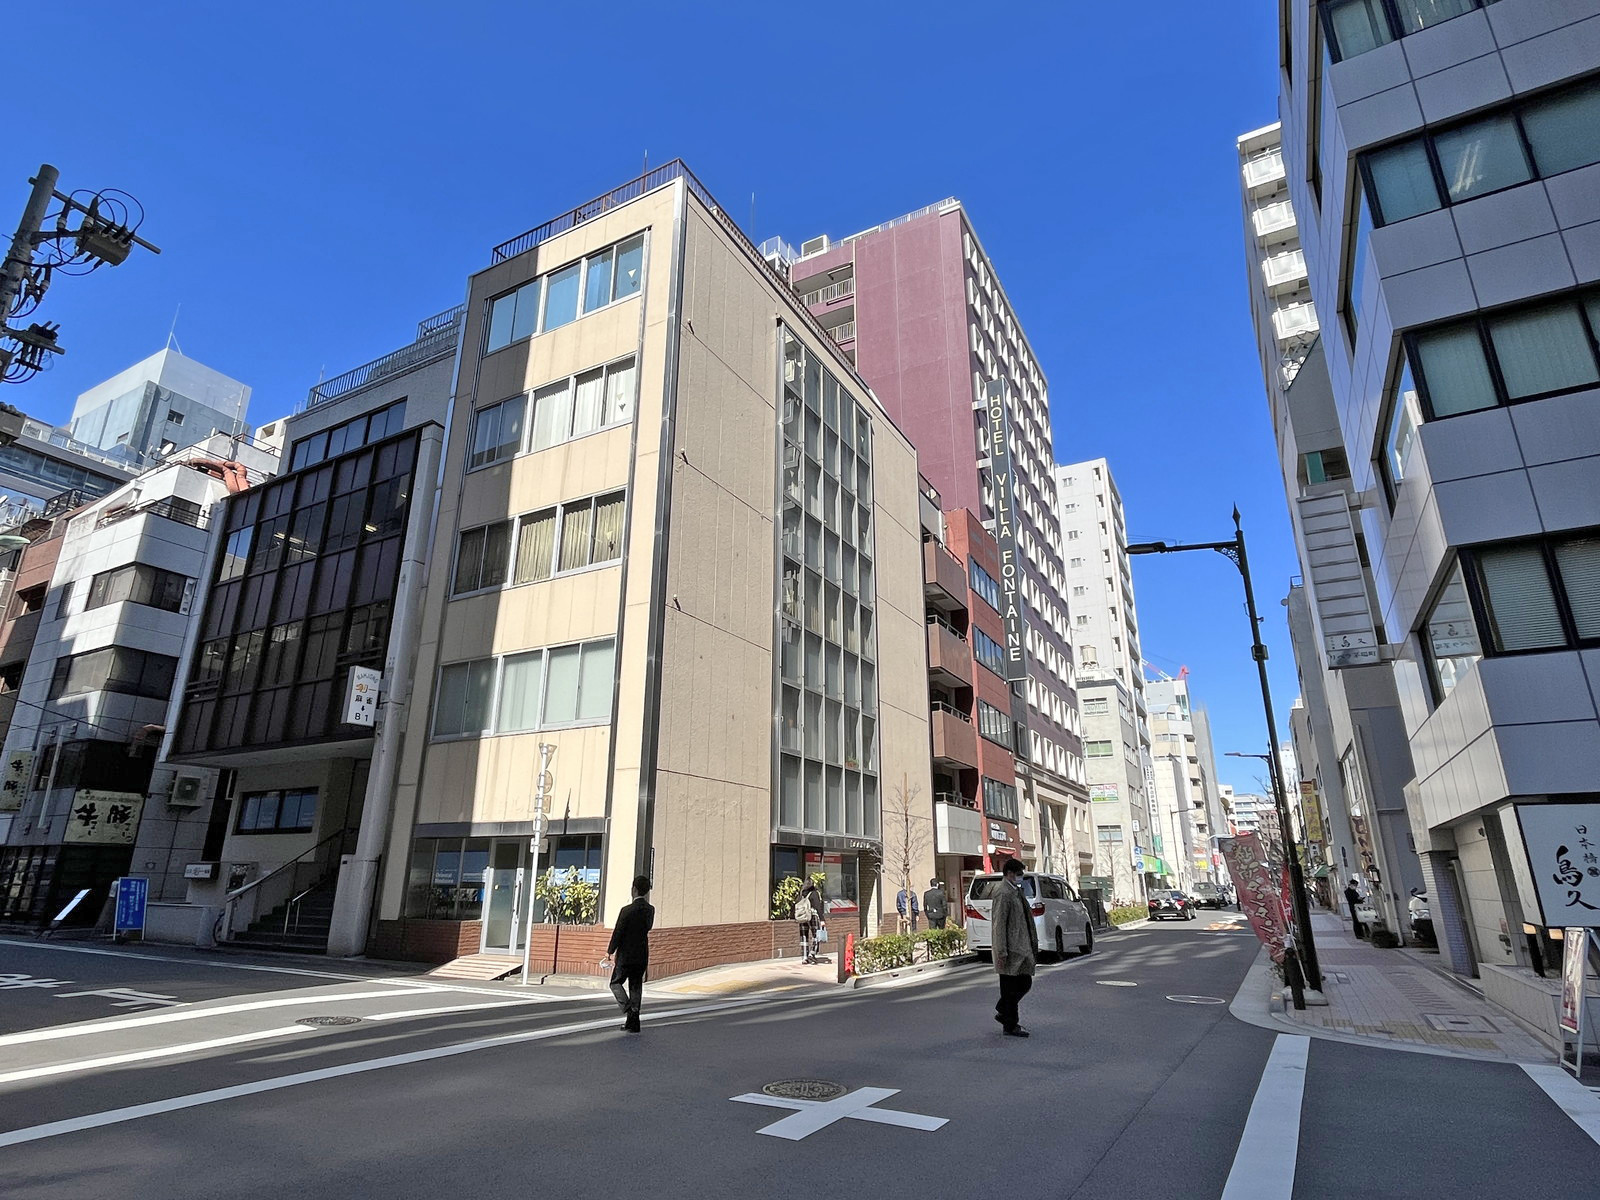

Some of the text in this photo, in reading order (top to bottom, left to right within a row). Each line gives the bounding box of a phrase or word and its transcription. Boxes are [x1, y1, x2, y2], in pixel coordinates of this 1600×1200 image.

[990, 397, 1022, 662] HOTEL VILLA FONTAINE
[1574, 824, 1598, 864] 日本橋
[1552, 845, 1600, 910] 鳥久
